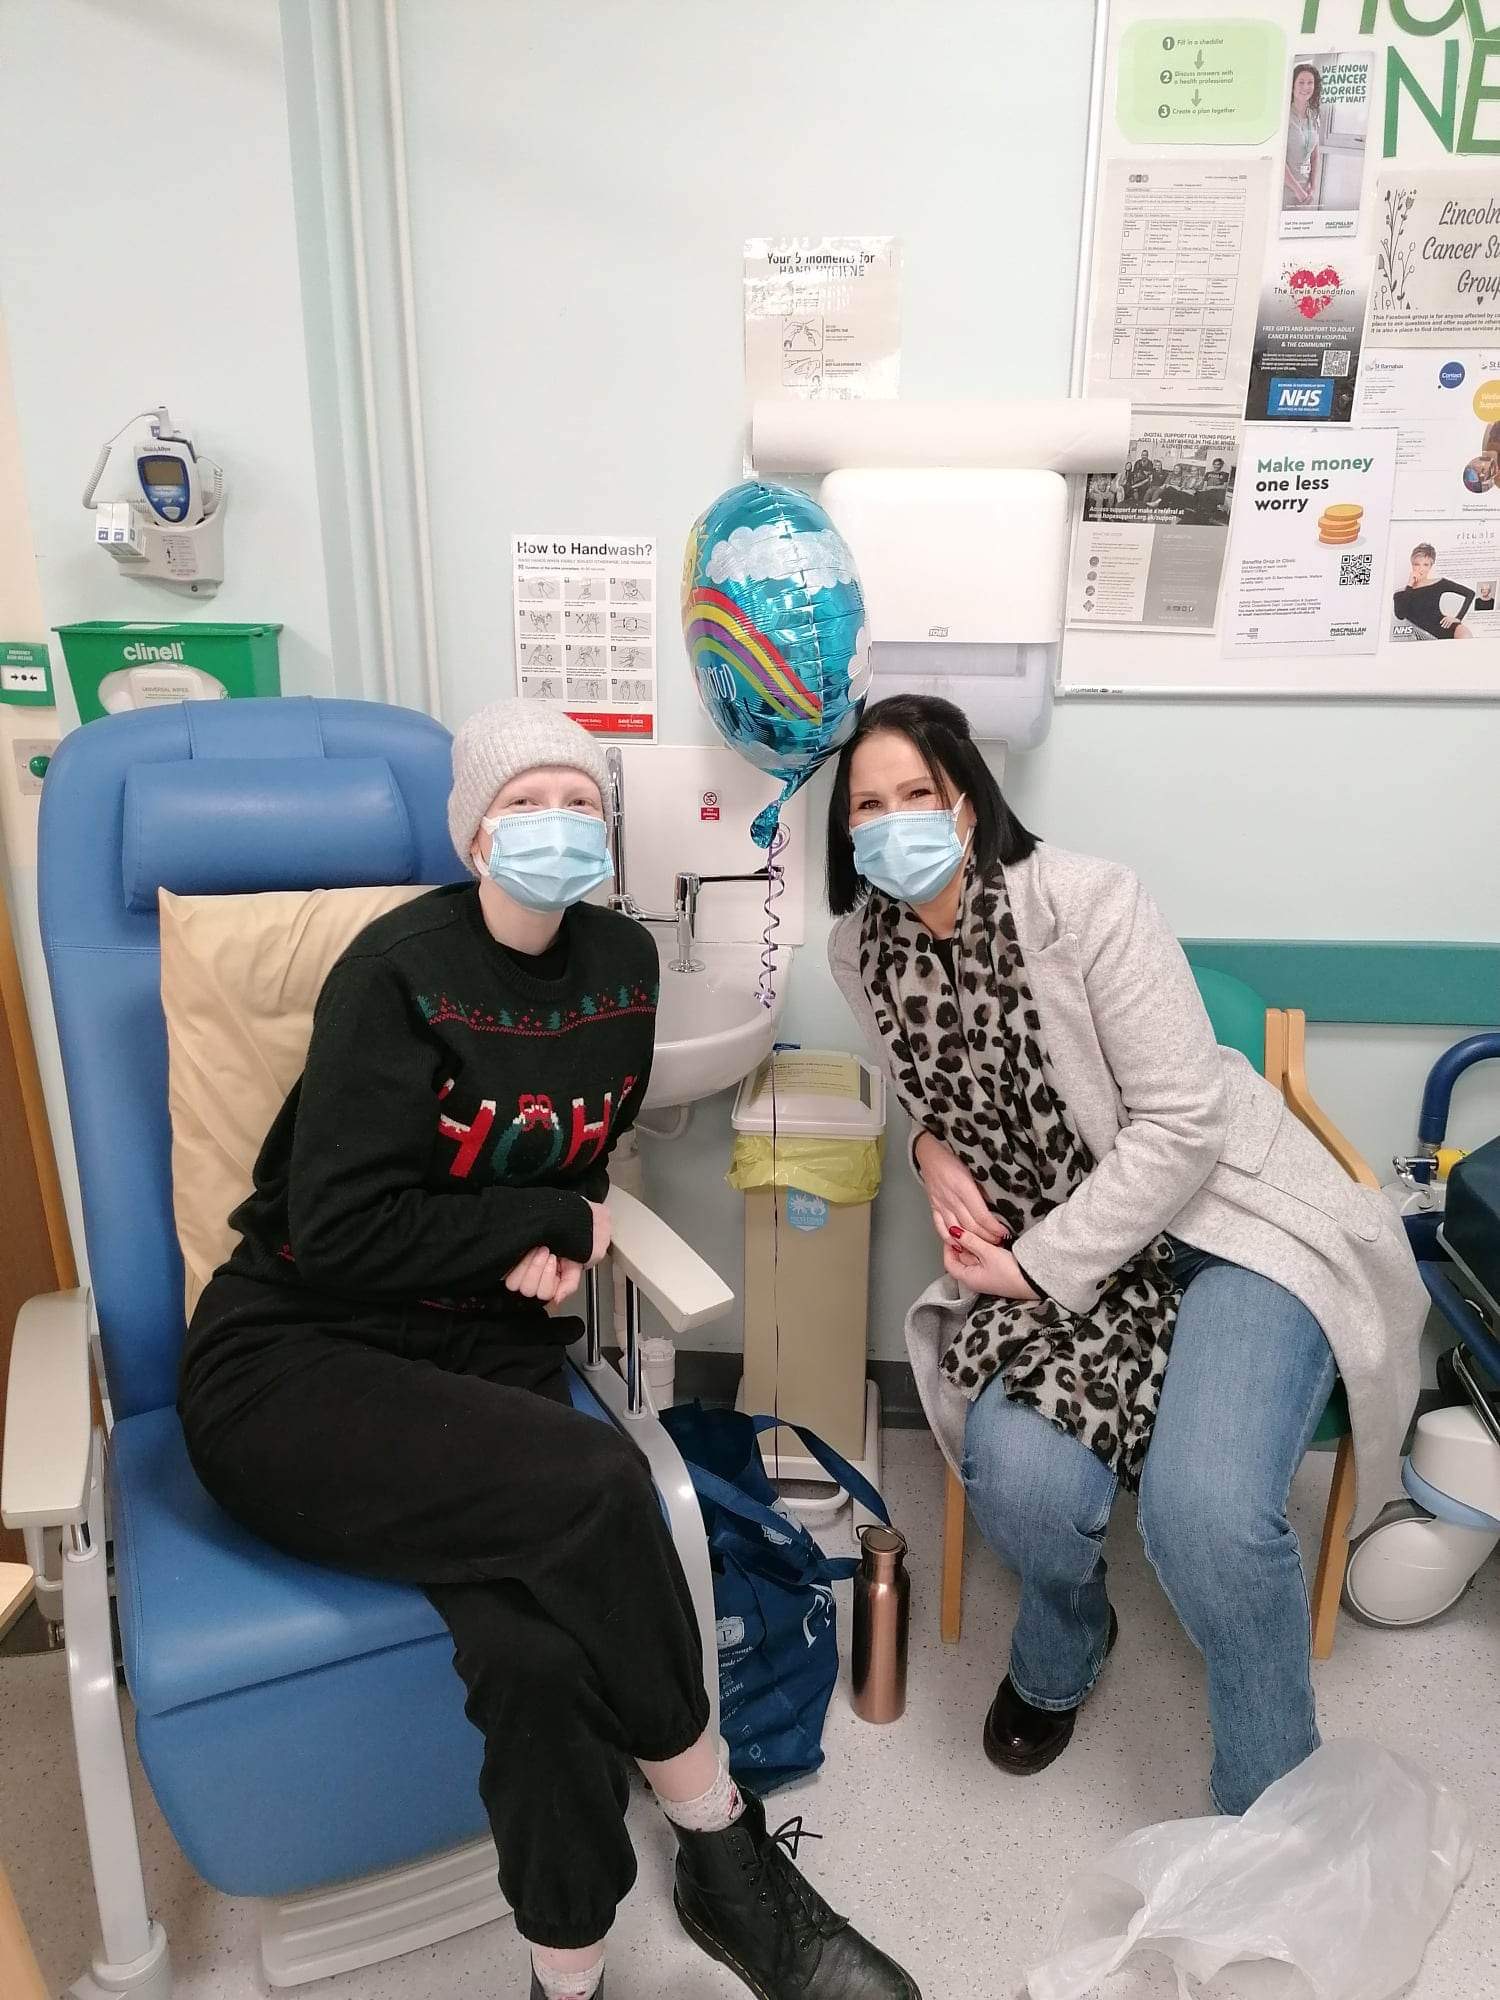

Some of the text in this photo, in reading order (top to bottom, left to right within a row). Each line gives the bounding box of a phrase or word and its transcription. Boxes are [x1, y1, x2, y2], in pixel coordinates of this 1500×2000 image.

[1322, 64, 1368, 74] WE KNOW
[1320, 73, 1367, 85] CANCER
[1320, 85, 1366, 96] WORRIES
[1320, 95, 1366, 104] CAN'T WAIT
[1422, 236, 1482, 260] Cancer
[767, 252, 792, 264] Your
[860, 251, 876, 264] for
[1274, 287, 1355, 295] The Lewis Foundation
[1441, 371, 1462, 379] Contact
[1278, 389, 1323, 407] NHS
[1257, 456, 1374, 473] Make money
[1255, 475, 1329, 492] one less
[1254, 498, 1309, 513] worry
[1456, 529, 1496, 540] rituals
[517, 541, 653, 556] How to Handwash?
[1393, 626, 1414, 635] NHS
[123, 643, 183, 661] clinell
